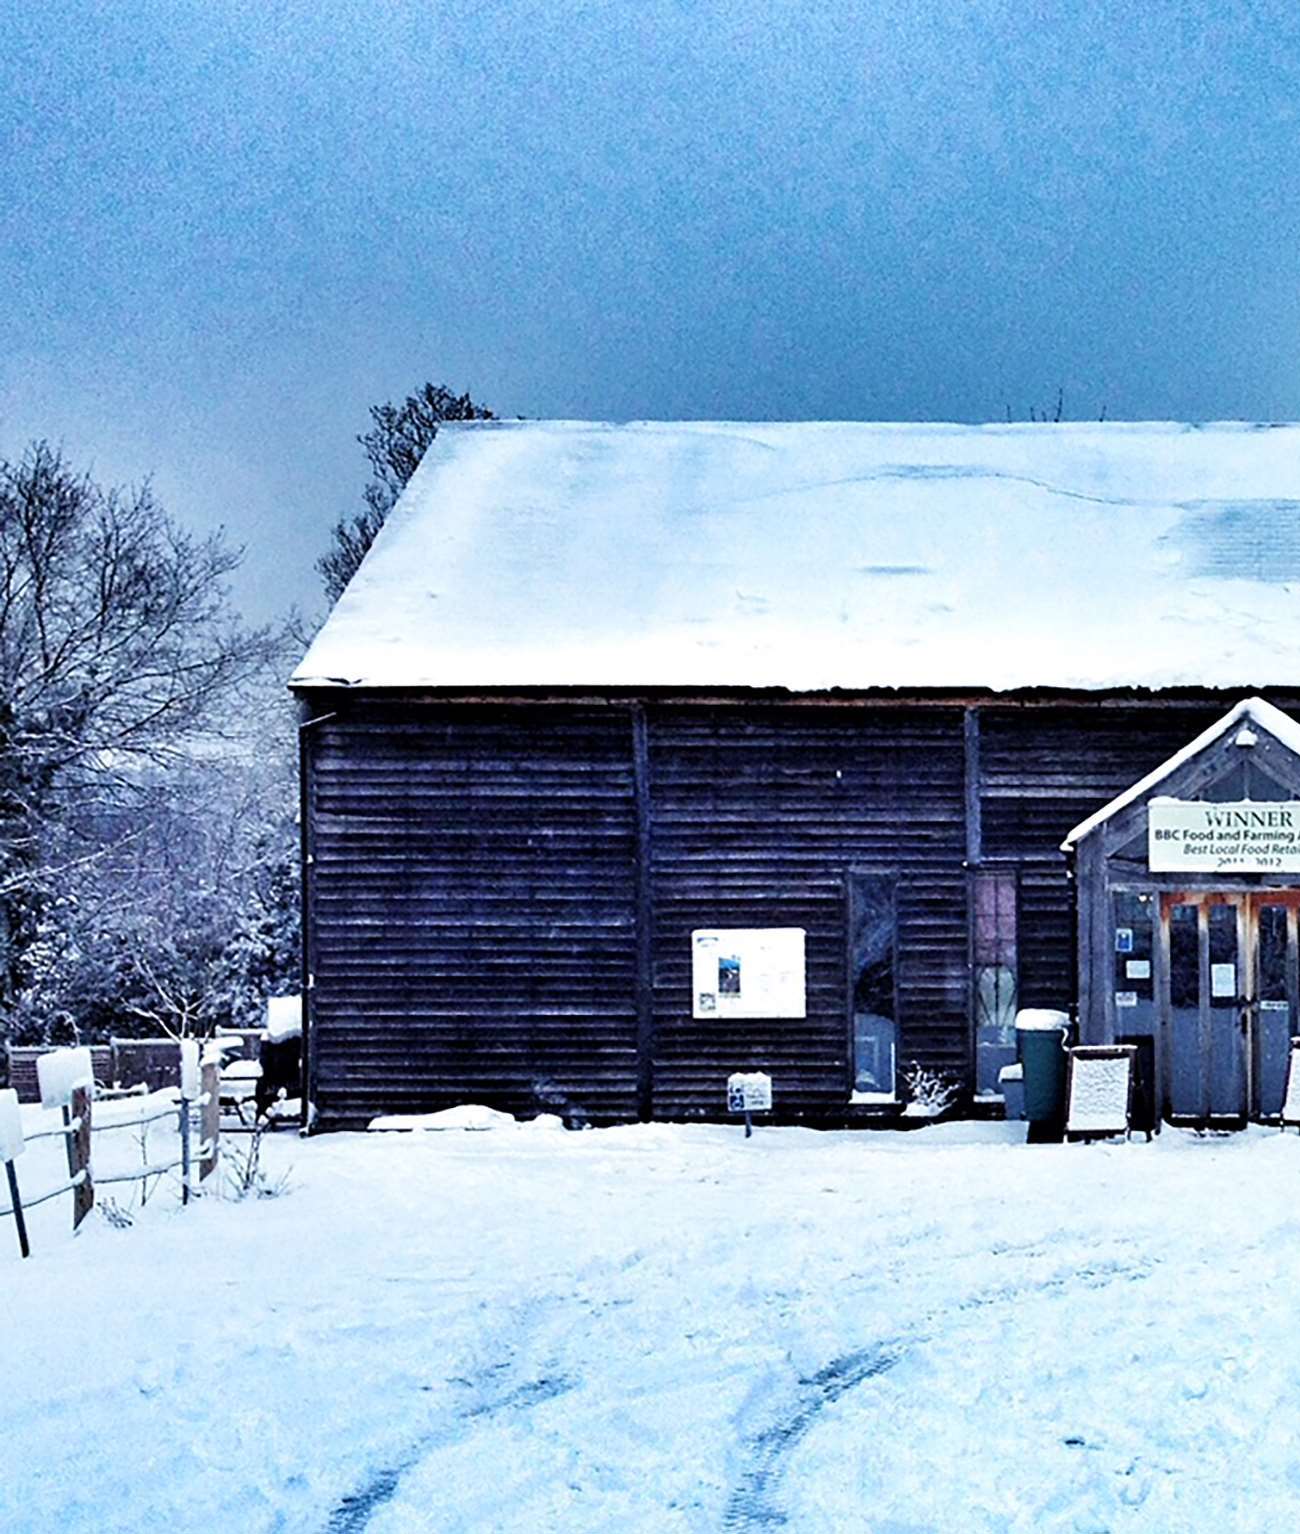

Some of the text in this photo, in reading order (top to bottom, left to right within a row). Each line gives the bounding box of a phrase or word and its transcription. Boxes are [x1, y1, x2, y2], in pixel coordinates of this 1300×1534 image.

[1205, 811, 1293, 827] WINNER
[1155, 829, 1180, 841] BBC
[1183, 829, 1214, 841] Food
[1216, 829, 1241, 841] and
[1243, 829, 1295, 844] Farming
[1183, 843, 1208, 855] Best
[1209, 843, 1240, 855] Local
[1241, 843, 1270, 855] Food
